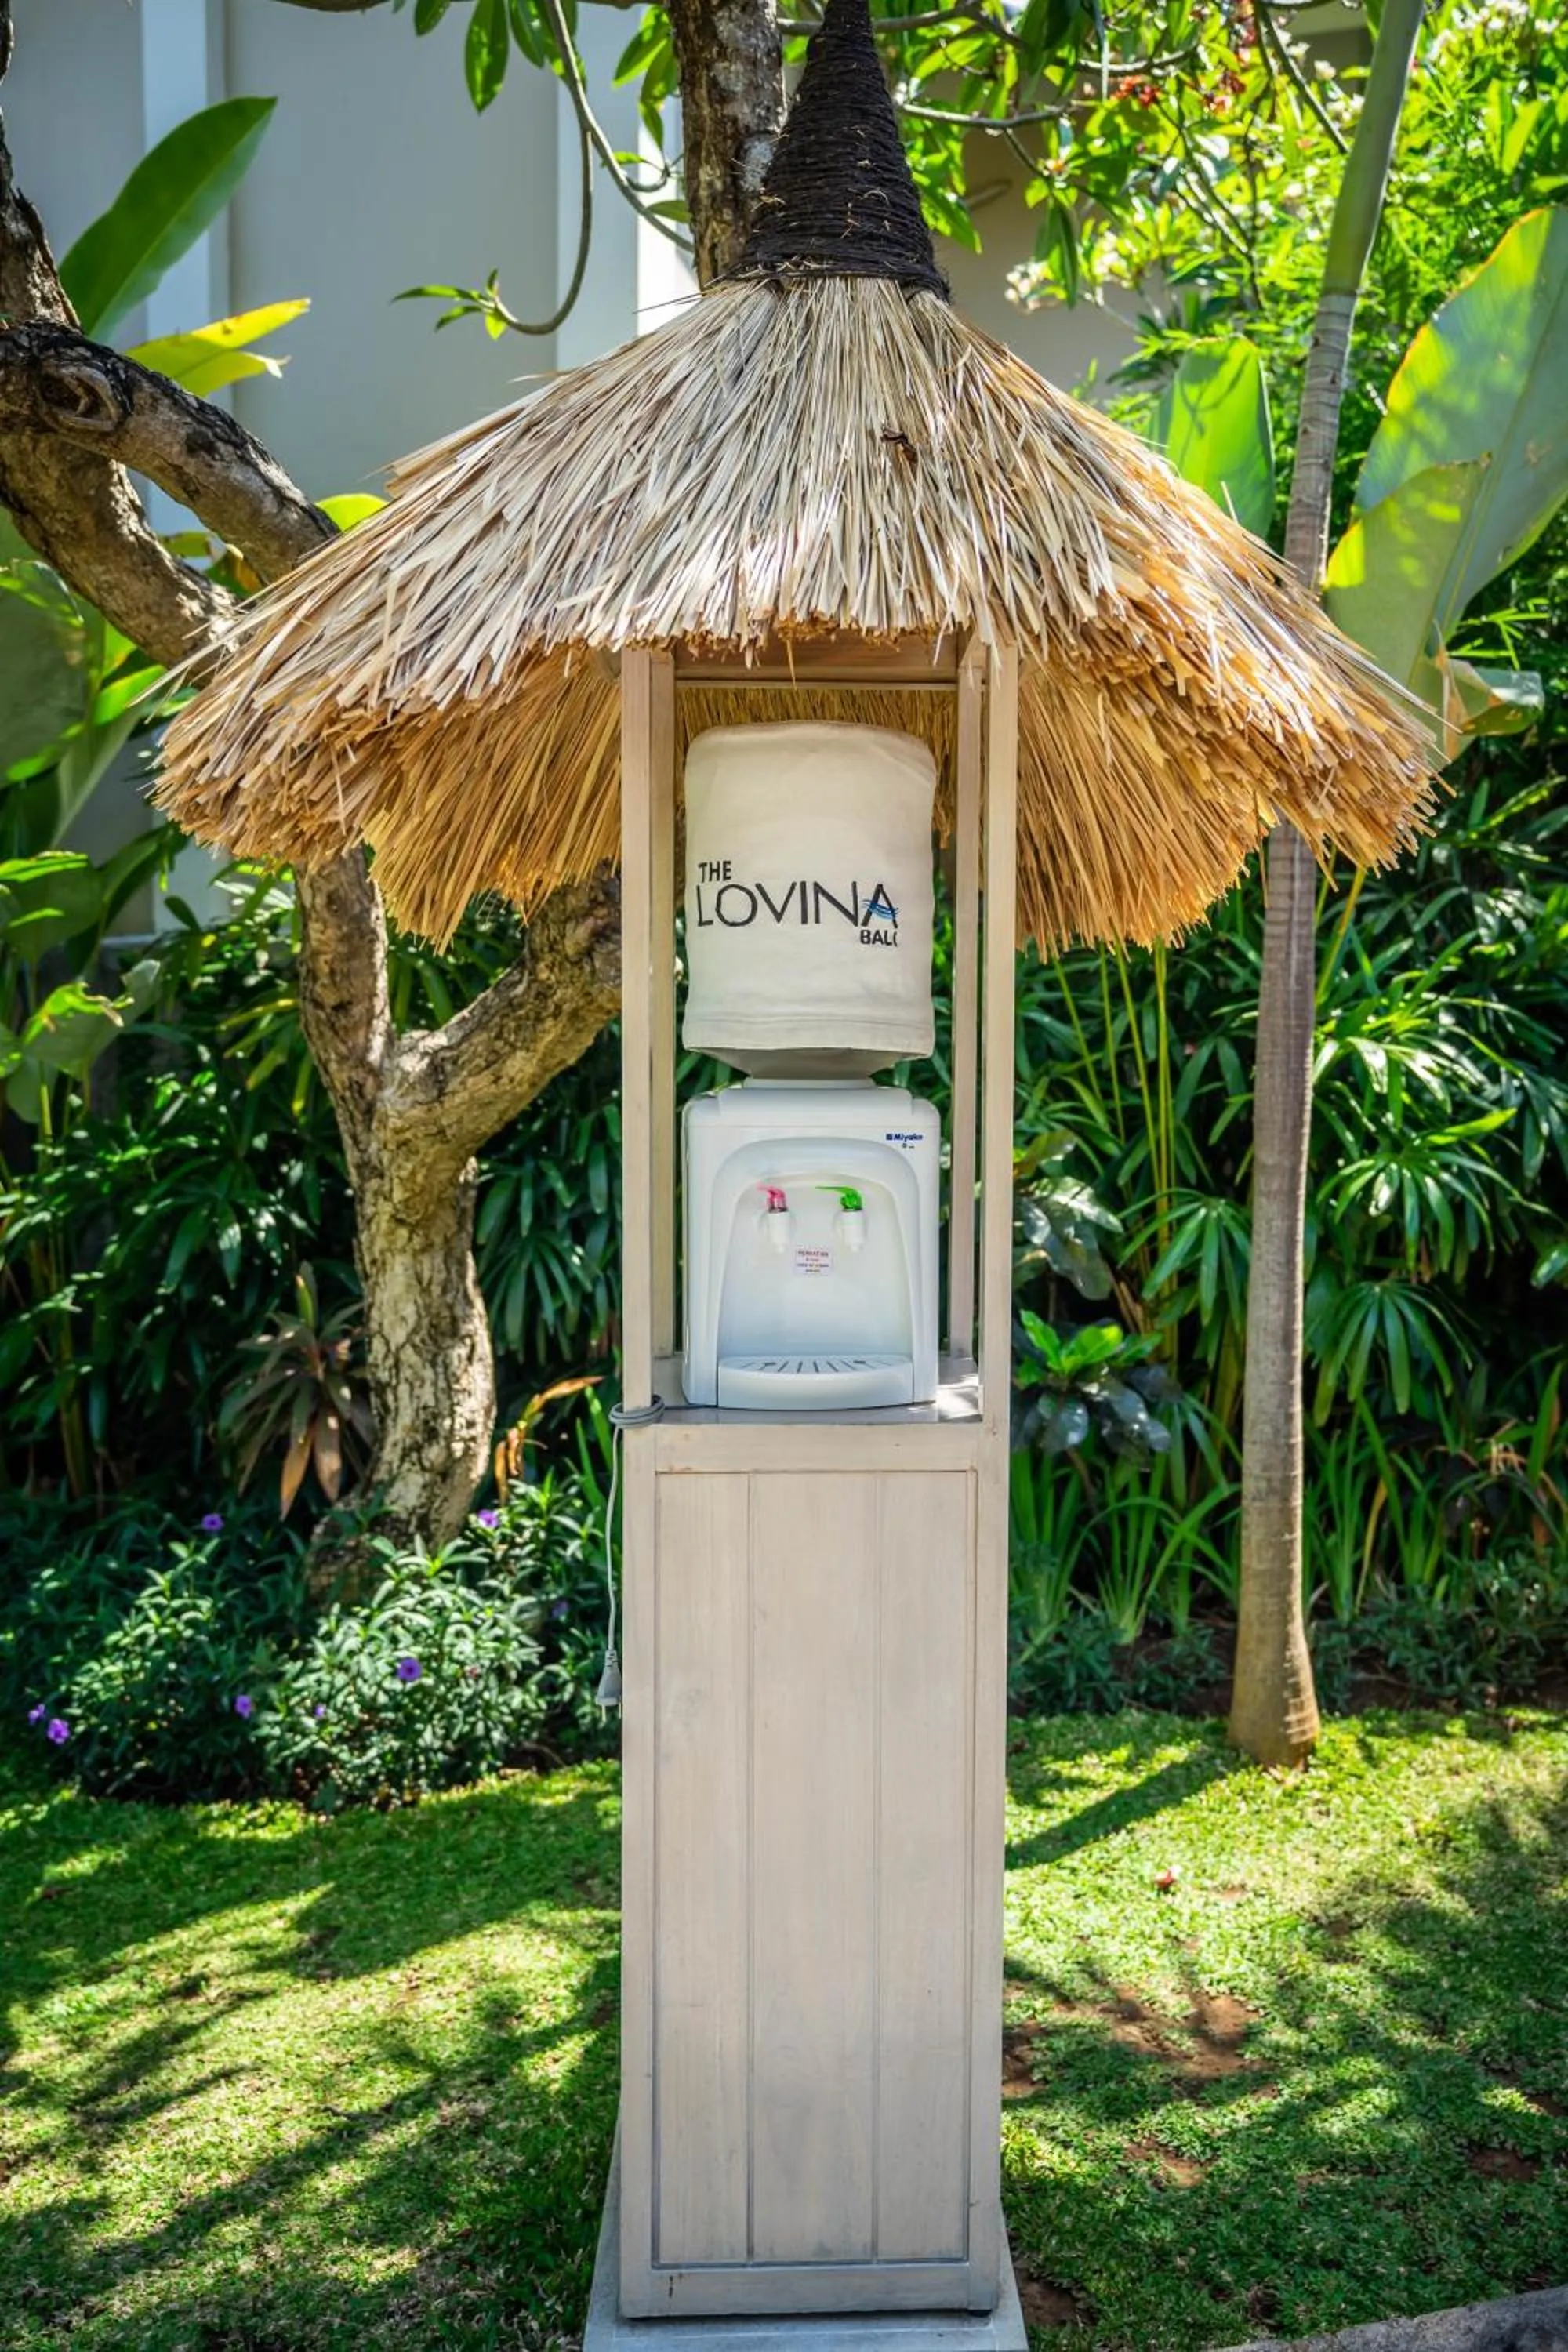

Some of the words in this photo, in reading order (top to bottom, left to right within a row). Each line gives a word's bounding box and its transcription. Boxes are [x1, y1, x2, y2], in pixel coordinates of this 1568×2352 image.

[698, 860, 731, 883] THE
[696, 881, 899, 928] LOVINA
[860, 929, 898, 946] BALI
